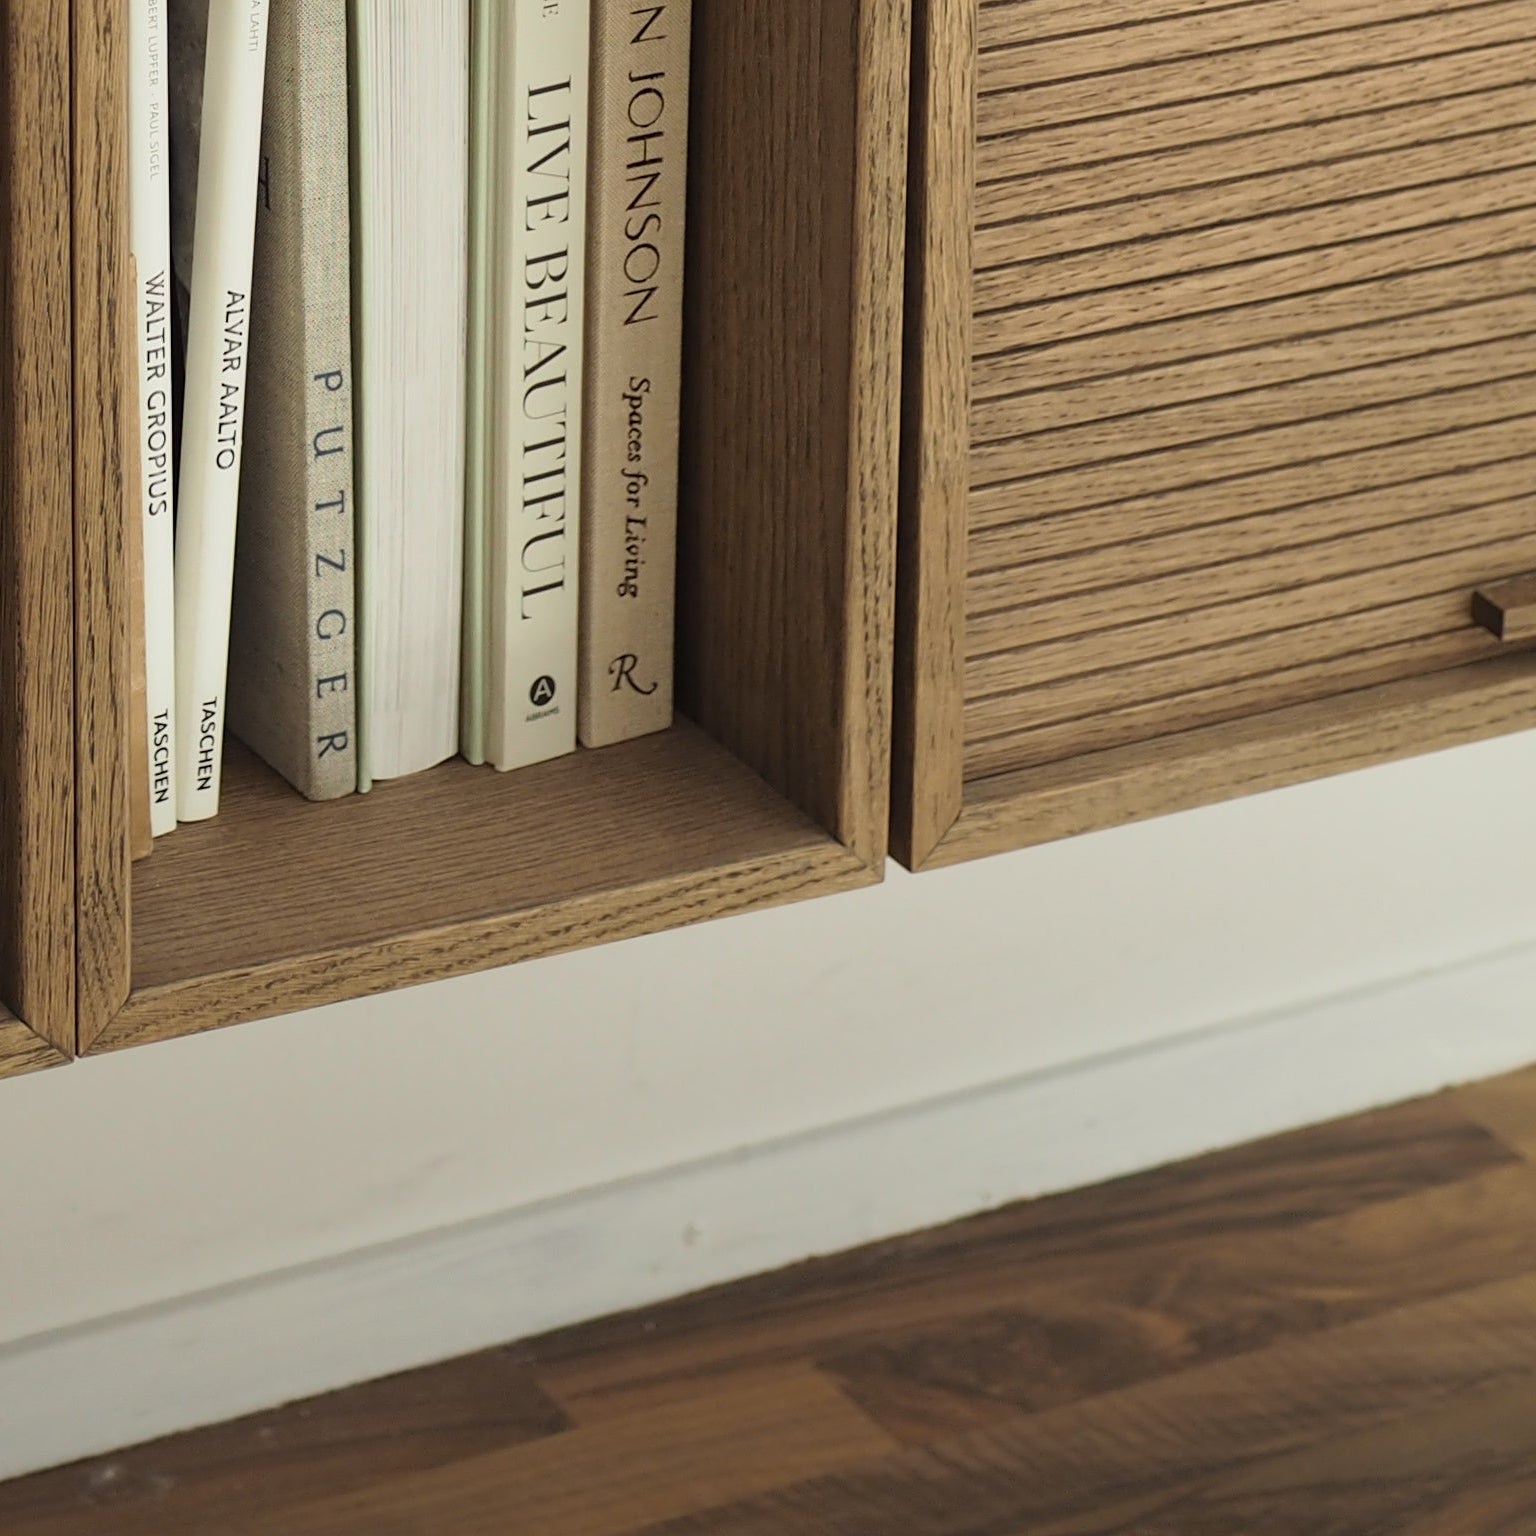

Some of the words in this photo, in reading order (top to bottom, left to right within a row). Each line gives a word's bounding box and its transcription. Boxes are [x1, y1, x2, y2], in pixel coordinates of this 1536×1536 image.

[148, 35, 158, 88] LUPFER
[248, 12, 260, 52] LAHTI
[149, 102, 159, 139] PAUL
[149, 141, 161, 180] SIGEL
[526, 74, 571, 232] LIVE
[623, 69, 665, 326] JOHNSON
[145, 270, 165, 381] WALTER
[221, 290, 245, 372] ALVAR
[147, 390, 167, 516] GROPIUS
[216, 382, 240, 471] AALTO
[521, 243, 569, 620] BEAUTIFUL
[621, 376, 652, 463] Spaces
[620, 468, 648, 508] for
[313, 369, 348, 758] PUTZGER
[616, 515, 647, 599] Living
[608, 653, 658, 696] R
[153, 708, 169, 804] TASCHEN
[197, 696, 217, 792] TASCHEN
